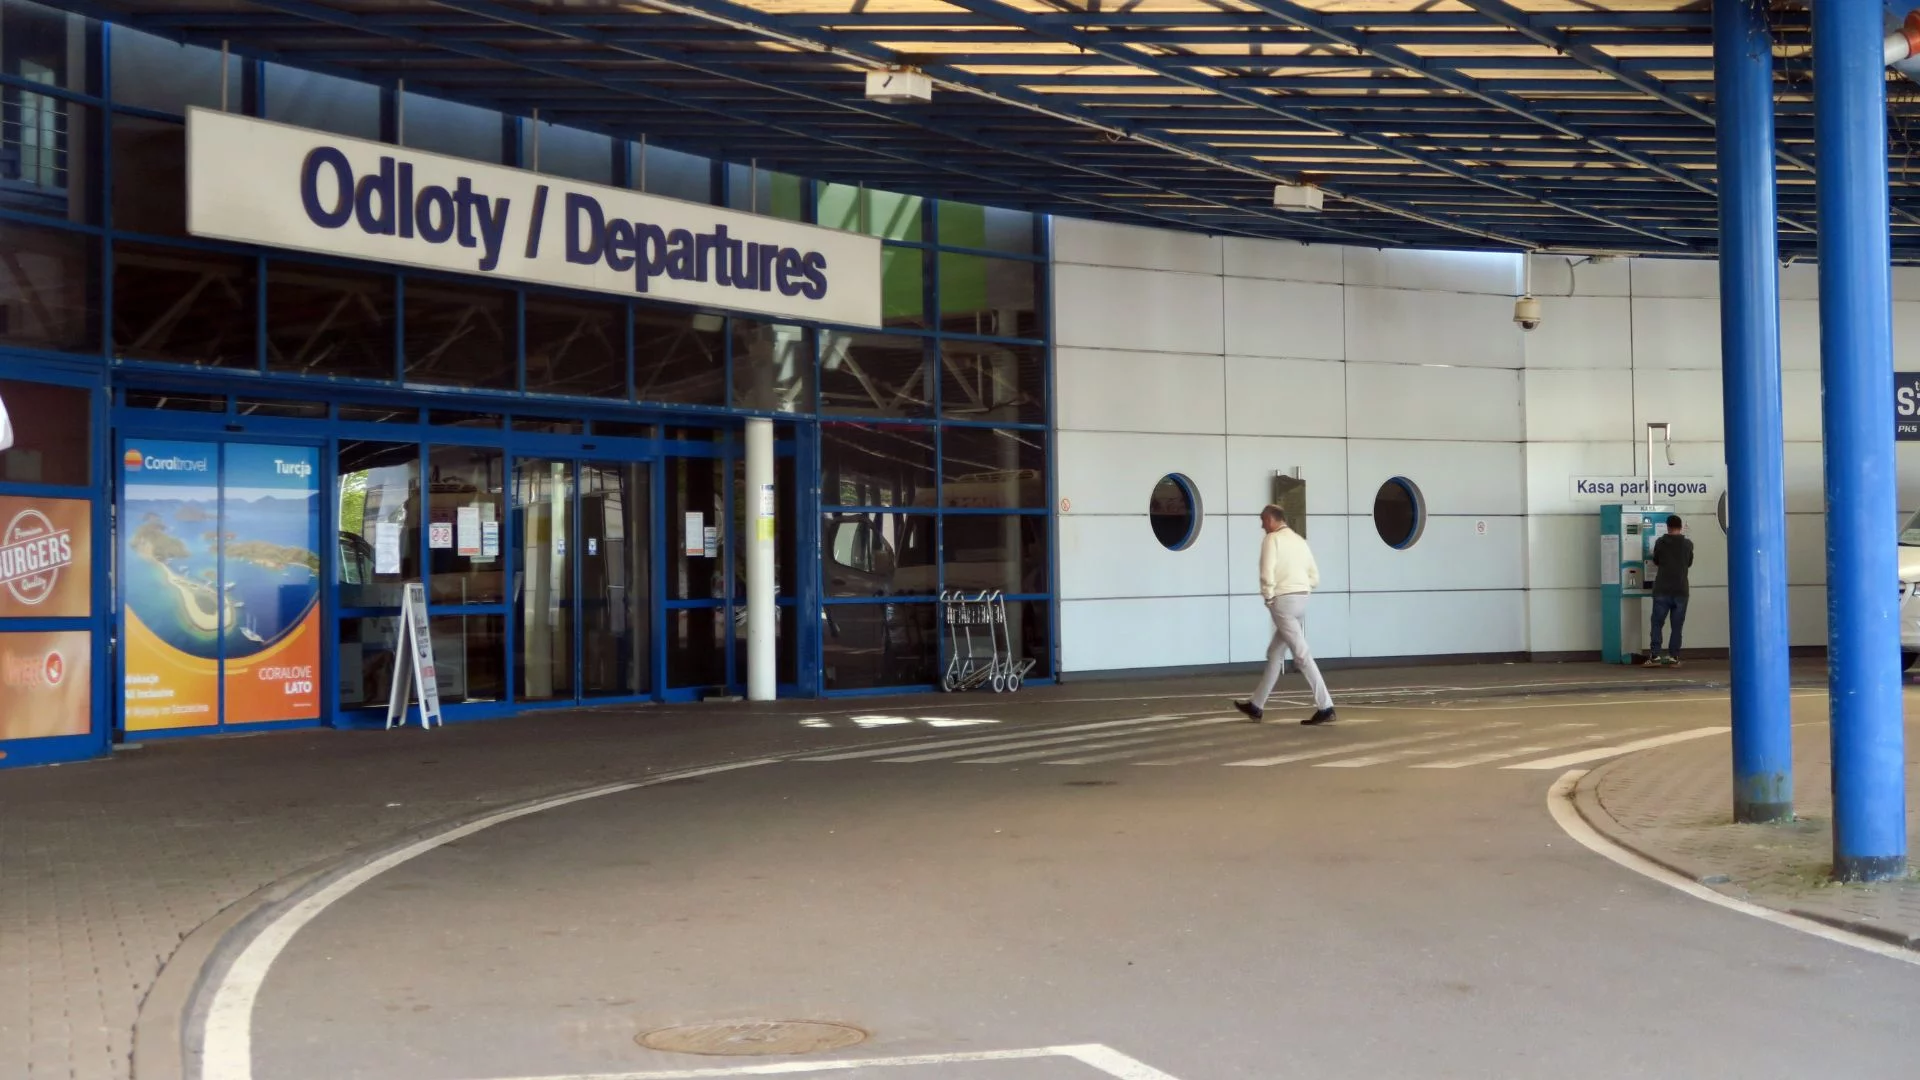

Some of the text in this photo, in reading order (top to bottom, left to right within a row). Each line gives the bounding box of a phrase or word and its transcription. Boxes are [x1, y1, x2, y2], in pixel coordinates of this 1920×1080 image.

[301, 146, 828, 300] Odloty / Departures
[1898, 425, 1918, 433] PKS
[274, 460, 312, 478] Turcja
[1577, 480, 1614, 494] Kasa
[0, 533, 72, 579] URGERS
[258, 665, 312, 680] CORALOVE
[284, 681, 313, 695] LATO
